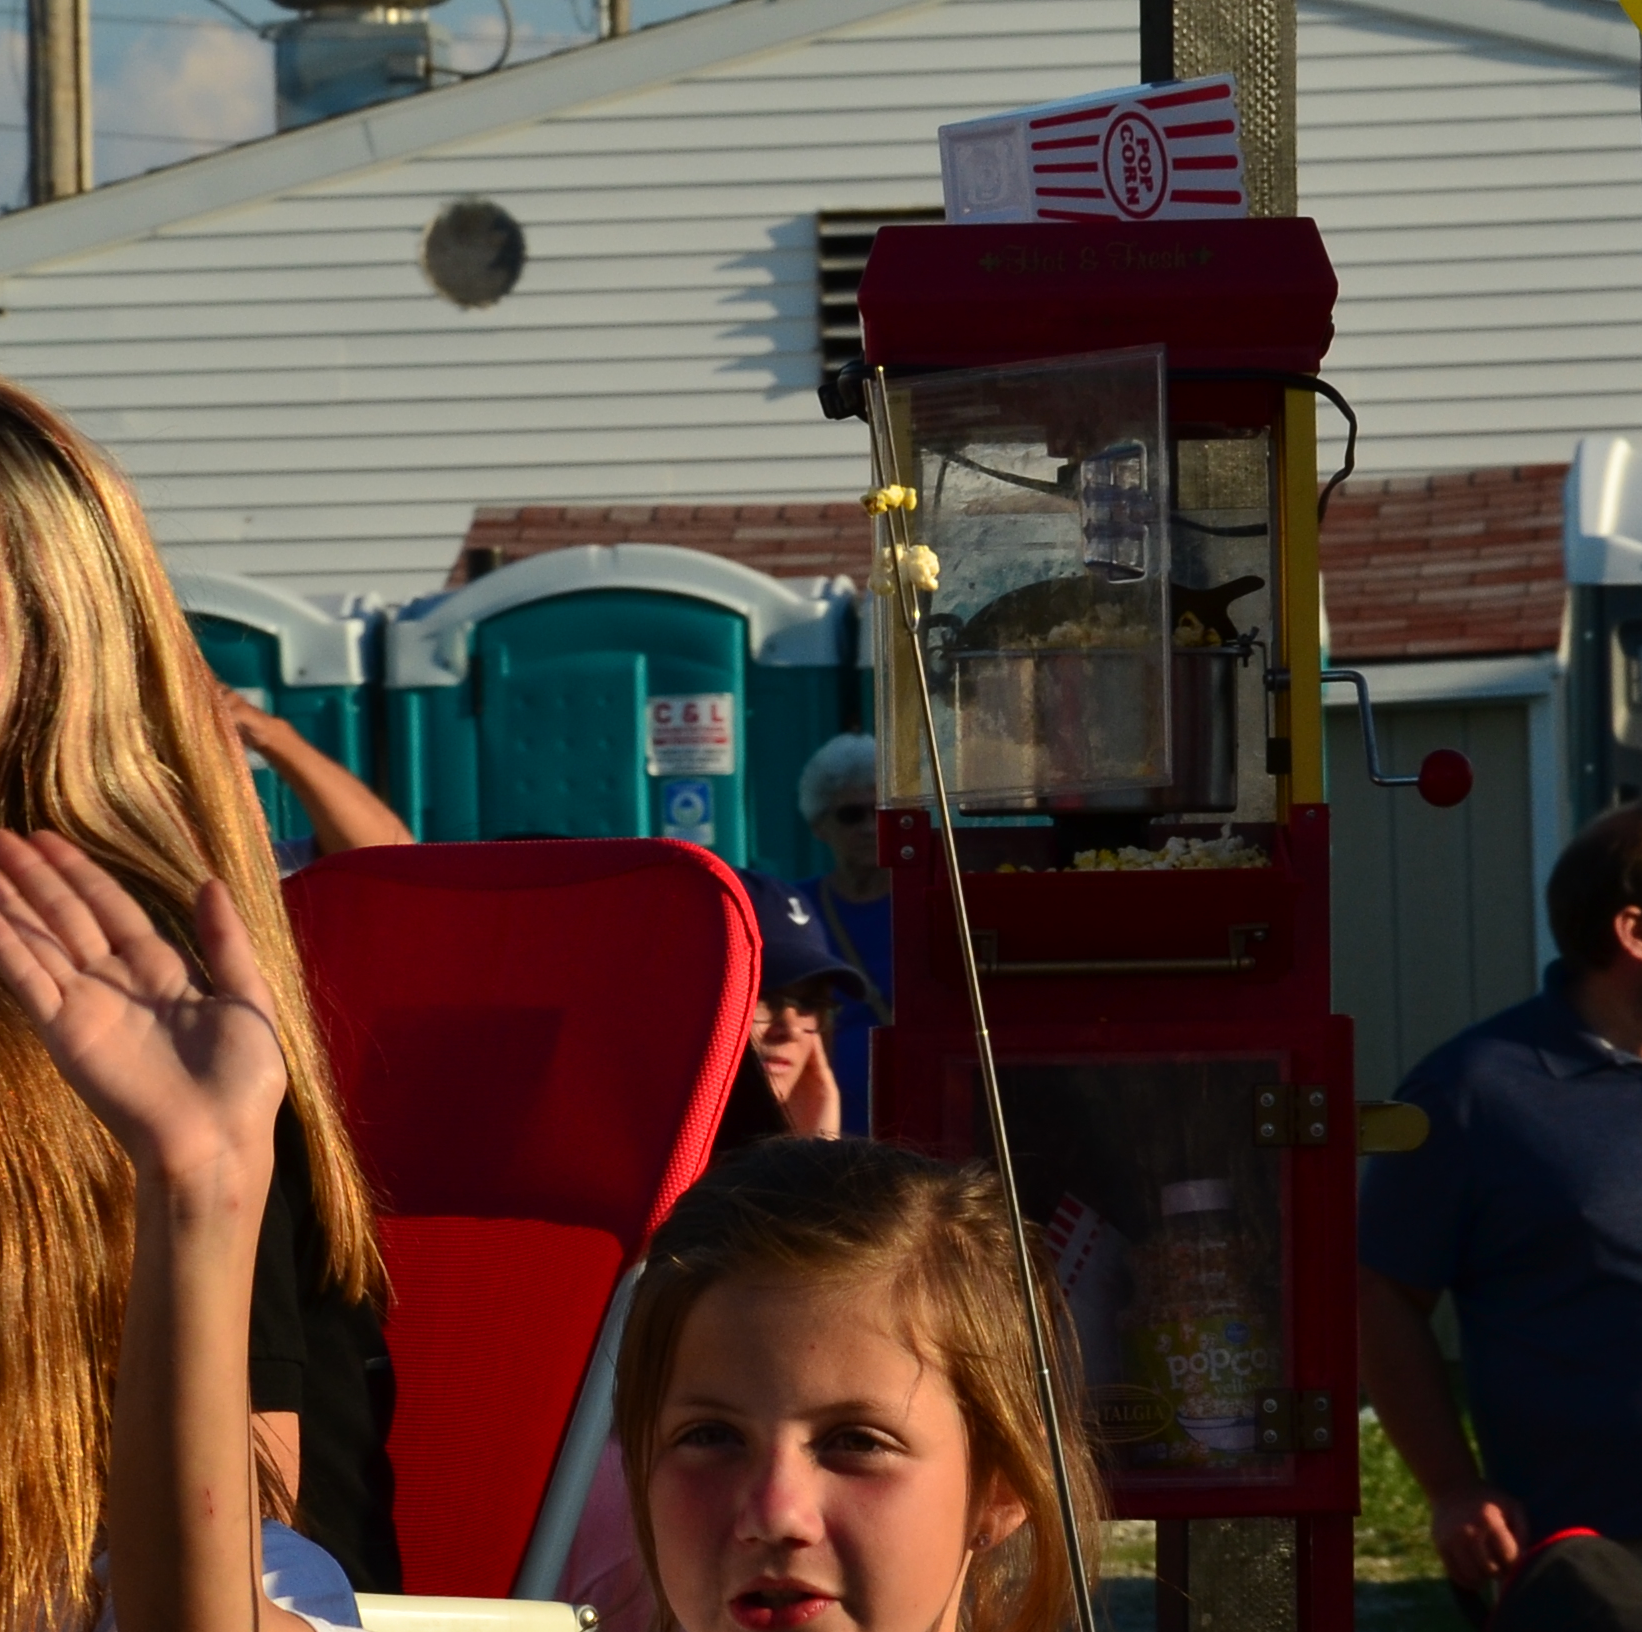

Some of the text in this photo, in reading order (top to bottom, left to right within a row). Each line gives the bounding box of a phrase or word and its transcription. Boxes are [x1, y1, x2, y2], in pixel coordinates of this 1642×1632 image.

[1120, 124, 1140, 205] CORN
[1136, 138, 1153, 193] POP
[653, 702, 671, 723] C
[710, 704, 724, 722] L
[1165, 1348, 1279, 1389] popco
[1095, 1404, 1167, 1423] TALGIA
